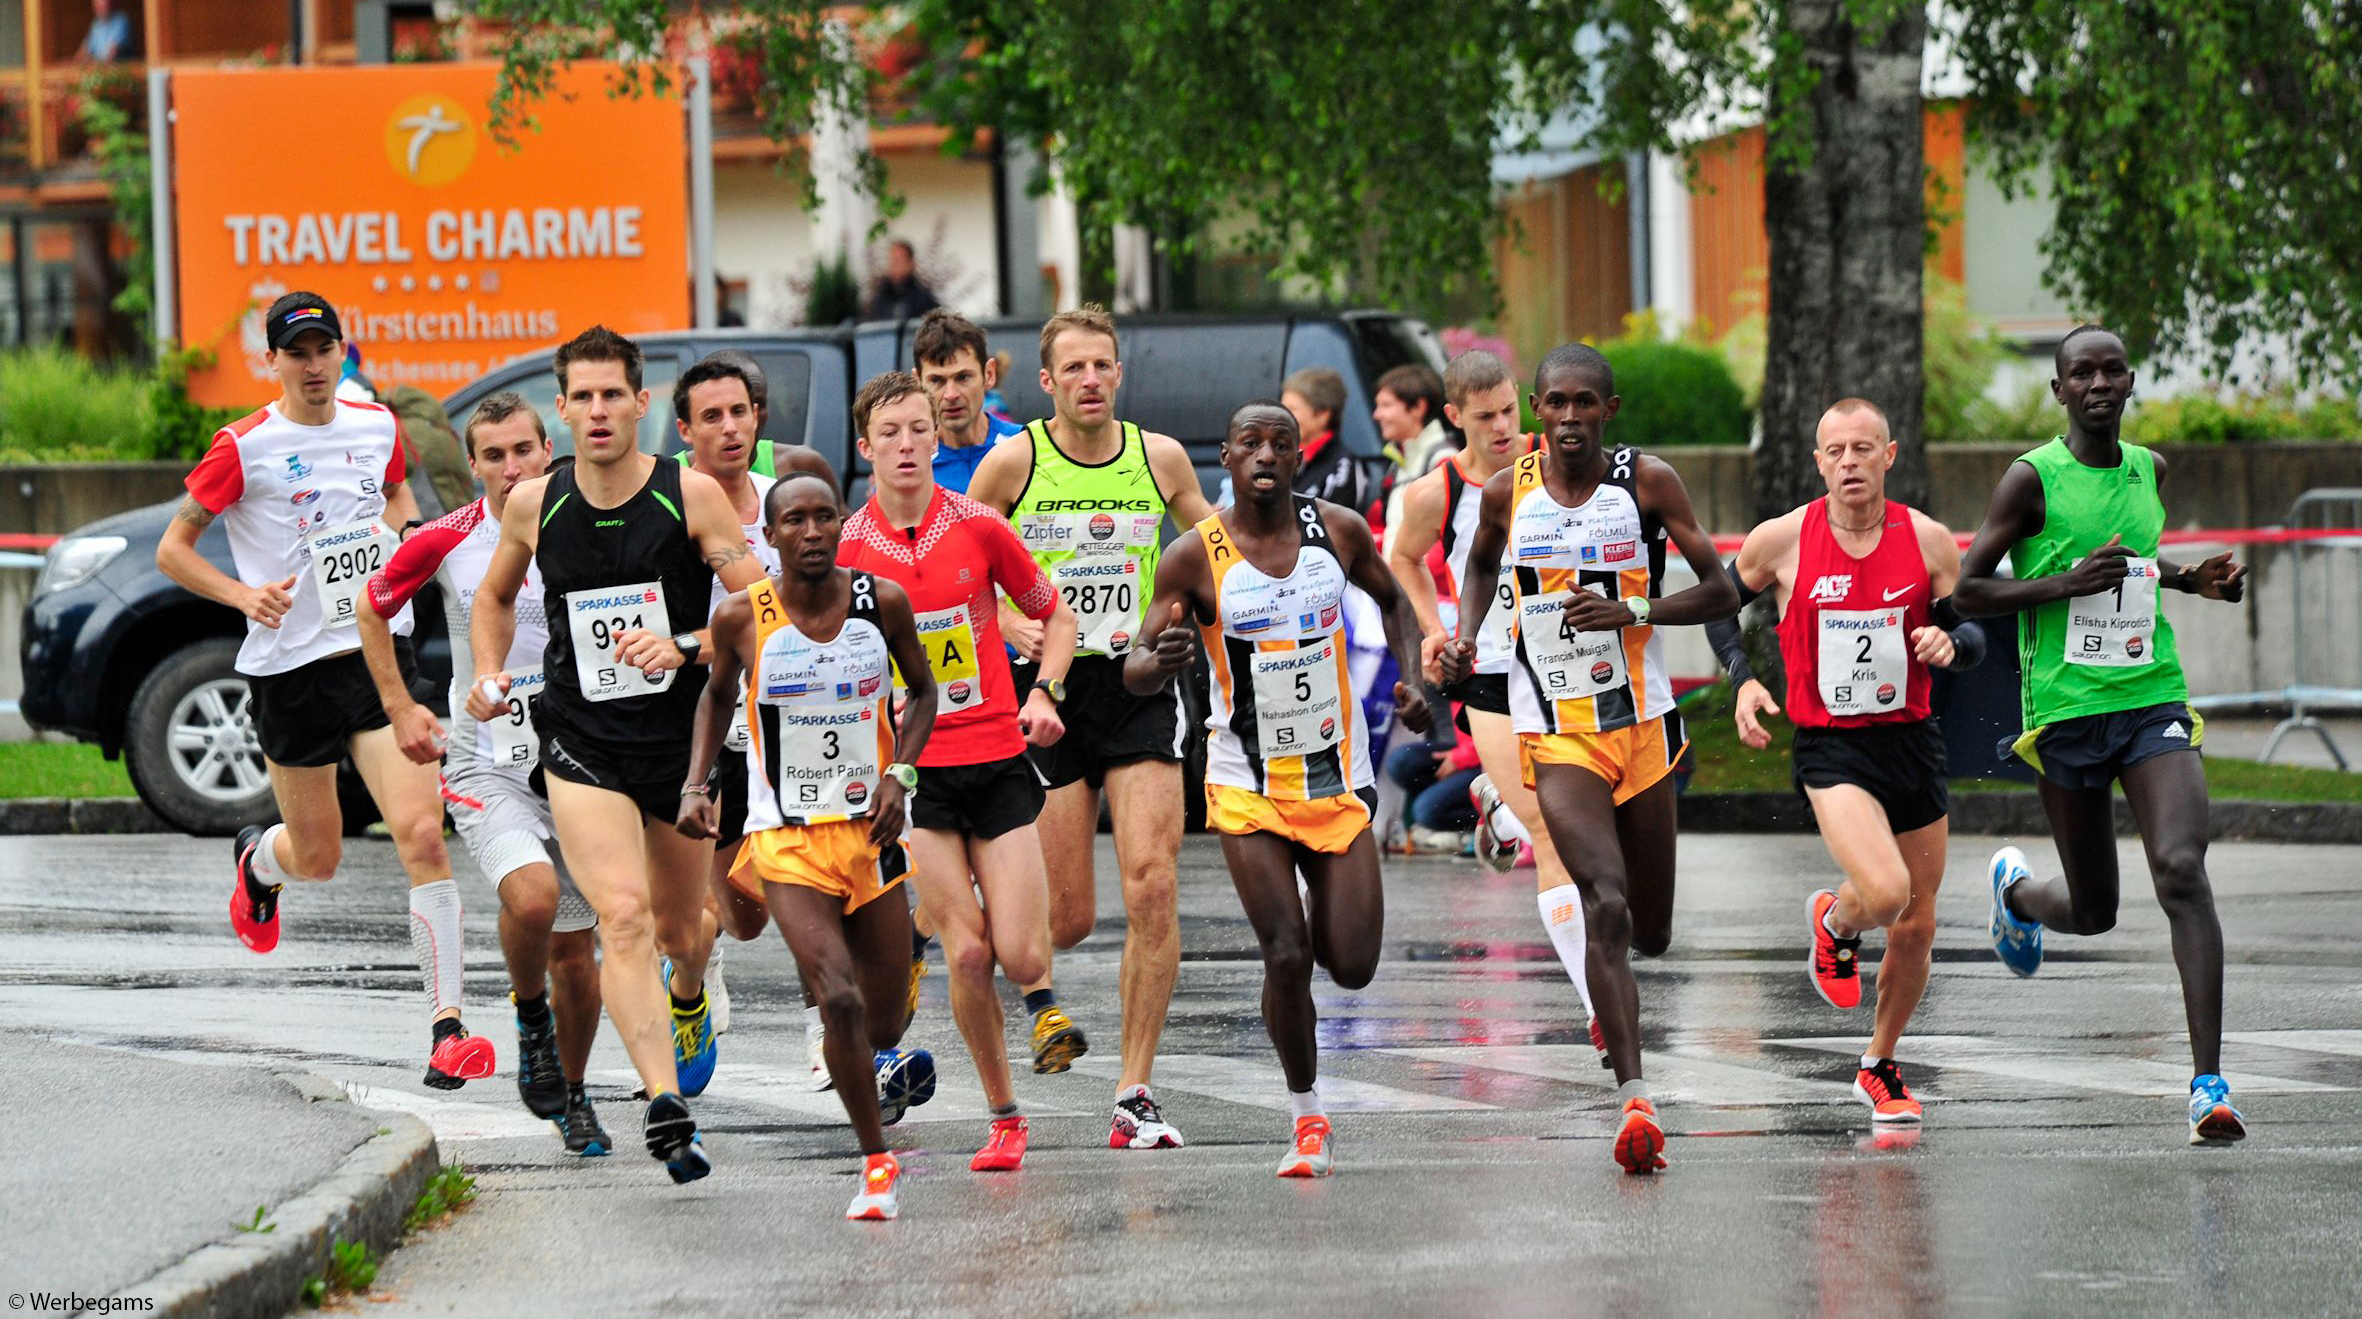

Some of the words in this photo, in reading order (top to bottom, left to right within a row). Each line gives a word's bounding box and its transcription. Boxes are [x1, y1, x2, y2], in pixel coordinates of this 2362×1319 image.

[225, 212, 412, 265] TRAVEL
[426, 206, 644, 261] CHARME
[343, 301, 558, 341] ürstenhaus
[1035, 500, 1151, 512] BROOKS
[315, 528, 371, 549] SPARKASSE
[1022, 524, 1073, 542] Zipfer
[1519, 533, 1564, 544] GARMIN
[324, 544, 381, 584] 2902
[1058, 564, 1124, 578] SPARKASSE
[1808, 574, 1853, 599] ACF
[2111, 579, 2124, 612] 1
[575, 594, 643, 611] SPARKASSE
[1062, 583, 1132, 614] 2870
[1232, 604, 1280, 620] GARMIN
[1525, 602, 1565, 616] SPARKA
[915, 618, 953, 632] KASSE
[1559, 614, 1576, 644] 4
[1825, 617, 1886, 630] SPARKASSE
[2074, 615, 2107, 628] Elisha
[2110, 617, 2151, 631] Kiprotich
[942, 639, 963, 667] A
[1537, 652, 1574, 665] Francis
[1576, 641, 1611, 659] Muigai
[1855, 635, 1873, 663] 2
[1258, 651, 1323, 673] SPARKASSE
[768, 670, 817, 682] GARMIN
[1852, 669, 1877, 682] Kris
[1294, 672, 1311, 702] 5
[787, 712, 859, 726] SPARKASSE
[1262, 706, 1309, 720] Nahashon
[822, 730, 840, 760] 3
[786, 766, 833, 780] Robert
[837, 763, 874, 779] Panin
